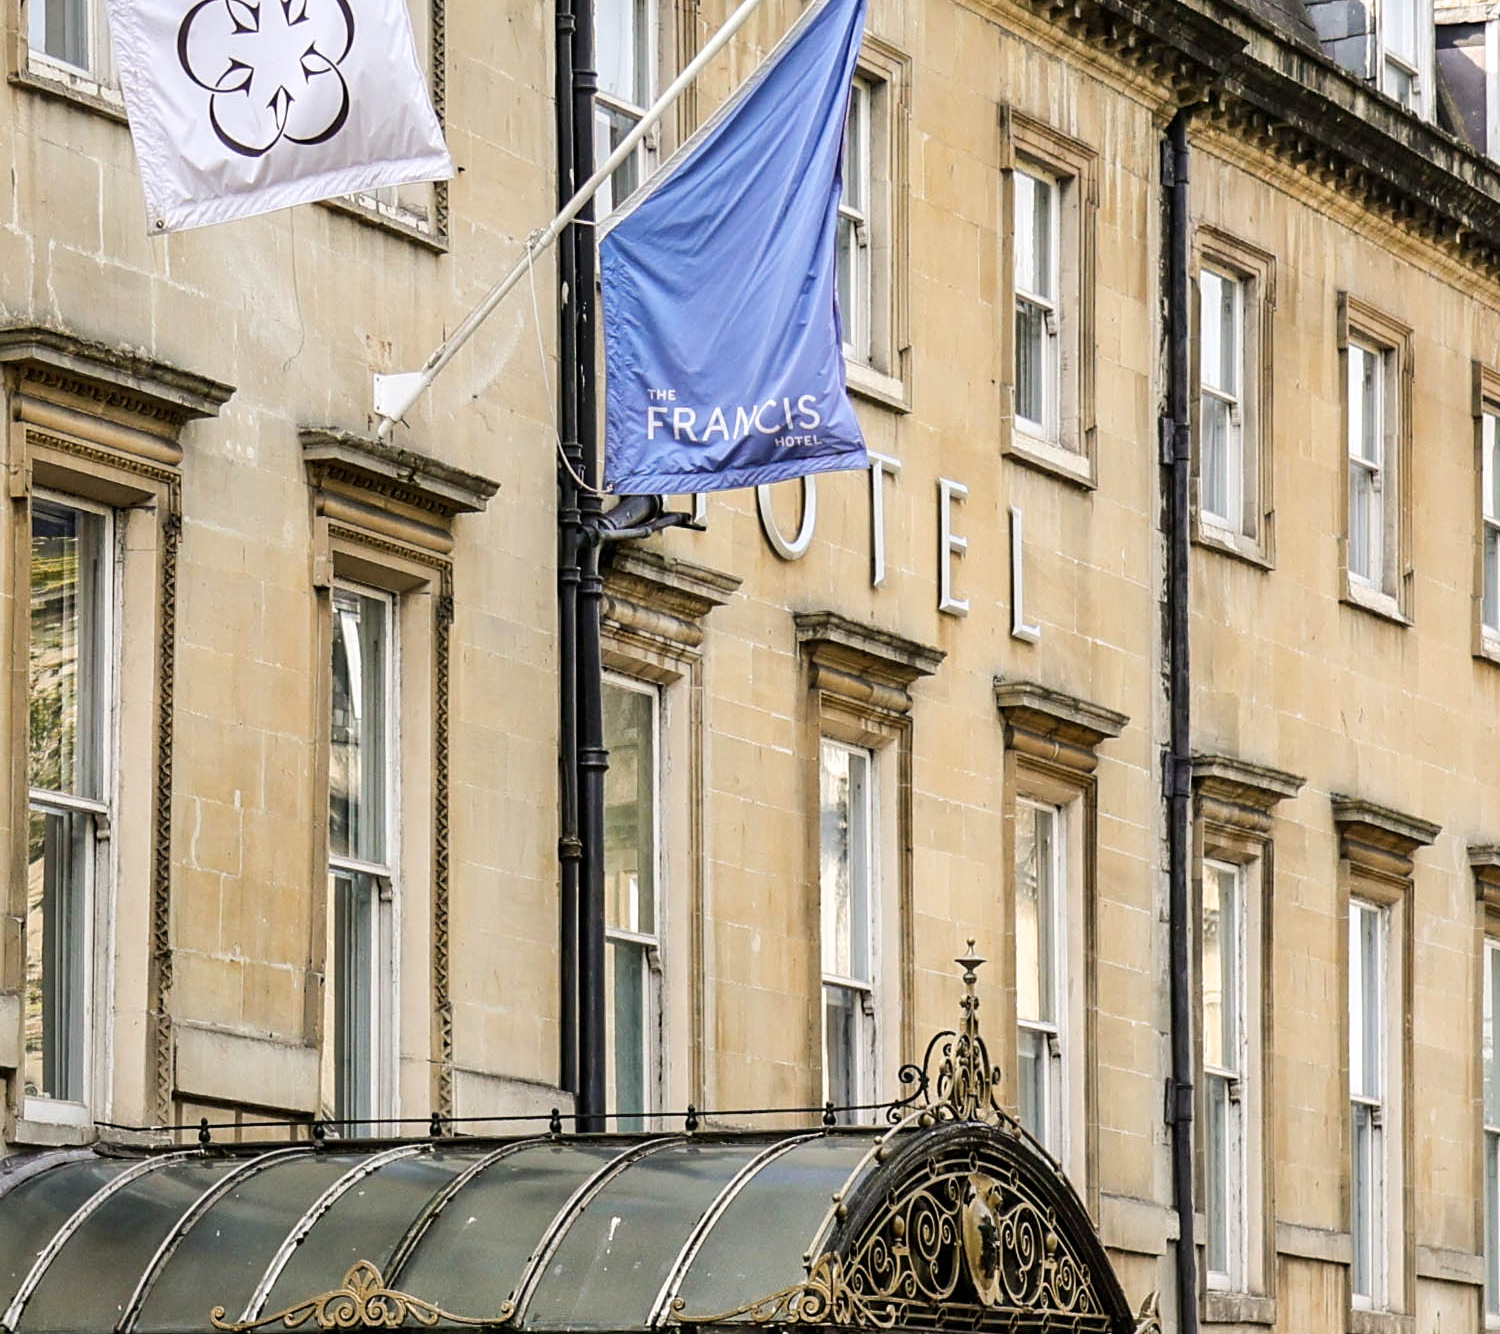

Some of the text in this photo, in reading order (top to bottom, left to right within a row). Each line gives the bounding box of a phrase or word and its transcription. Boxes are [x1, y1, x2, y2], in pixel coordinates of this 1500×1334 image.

[648, 388, 677, 402] THE
[647, 394, 821, 442] FRANCIS
[774, 434, 822, 447] HOTEL
[692, 450, 1041, 644] OTEL
